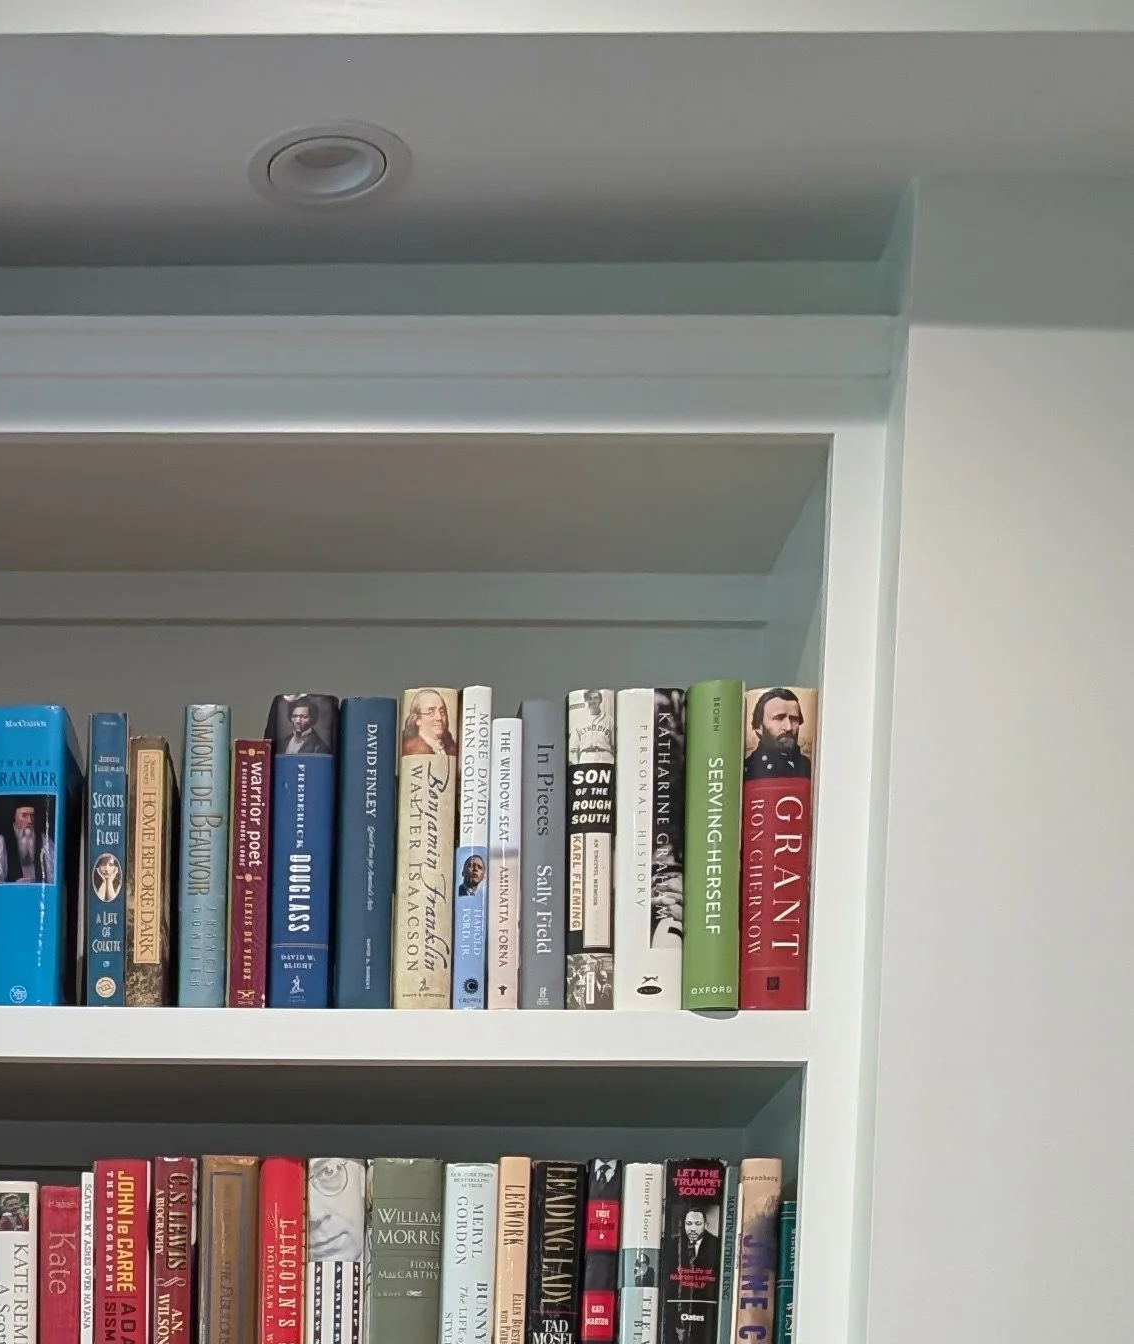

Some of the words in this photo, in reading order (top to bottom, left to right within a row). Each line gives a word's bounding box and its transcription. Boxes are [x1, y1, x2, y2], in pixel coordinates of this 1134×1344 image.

[249, 762, 262, 824] warrior
[572, 770, 611, 784] SON
[657, 712, 671, 825] KATHARINE
[142, 792, 155, 841] HOME
[708, 757, 723, 843] SERVING
[751, 799, 765, 841] RON
[140, 845, 155, 906] BEFORE
[248, 831, 263, 867] poet
[572, 836, 581, 868] KARL
[655, 833, 669, 920] GRAHAM
[771, 796, 803, 956] GRANT
[288, 854, 311, 932] DOUGLASS
[532, 865, 551, 905] Sally
[571, 873, 581, 928] FLEMING
[706, 849, 722, 934] HERSELF
[747, 849, 763, 956] CHERNOW
[139, 910, 155, 954] DARK
[536, 911, 551, 954] Field
[105, 1171, 113, 1202] THE
[117, 1171, 133, 1215] JOHN
[543, 1166, 577, 1251] LEADING
[117, 1220, 134, 1234] le
[377, 1208, 441, 1227] WILLIAM
[377, 1229, 442, 1245] MORRIS
[503, 1184, 525, 1246] LEGWORK
[13, 1243, 28, 1293] KATE
[48, 1232, 75, 1294] Kate
[105, 1207, 113, 1293] BIOGRAPHY
[117, 1238, 137, 1292] CARRÉ
[279, 1220, 296, 1327] LINCOLN'S
[740, 1235, 768, 1310] JANE
[539, 1257, 574, 1308] LADY
[474, 1282, 488, 1340] BUNNY
